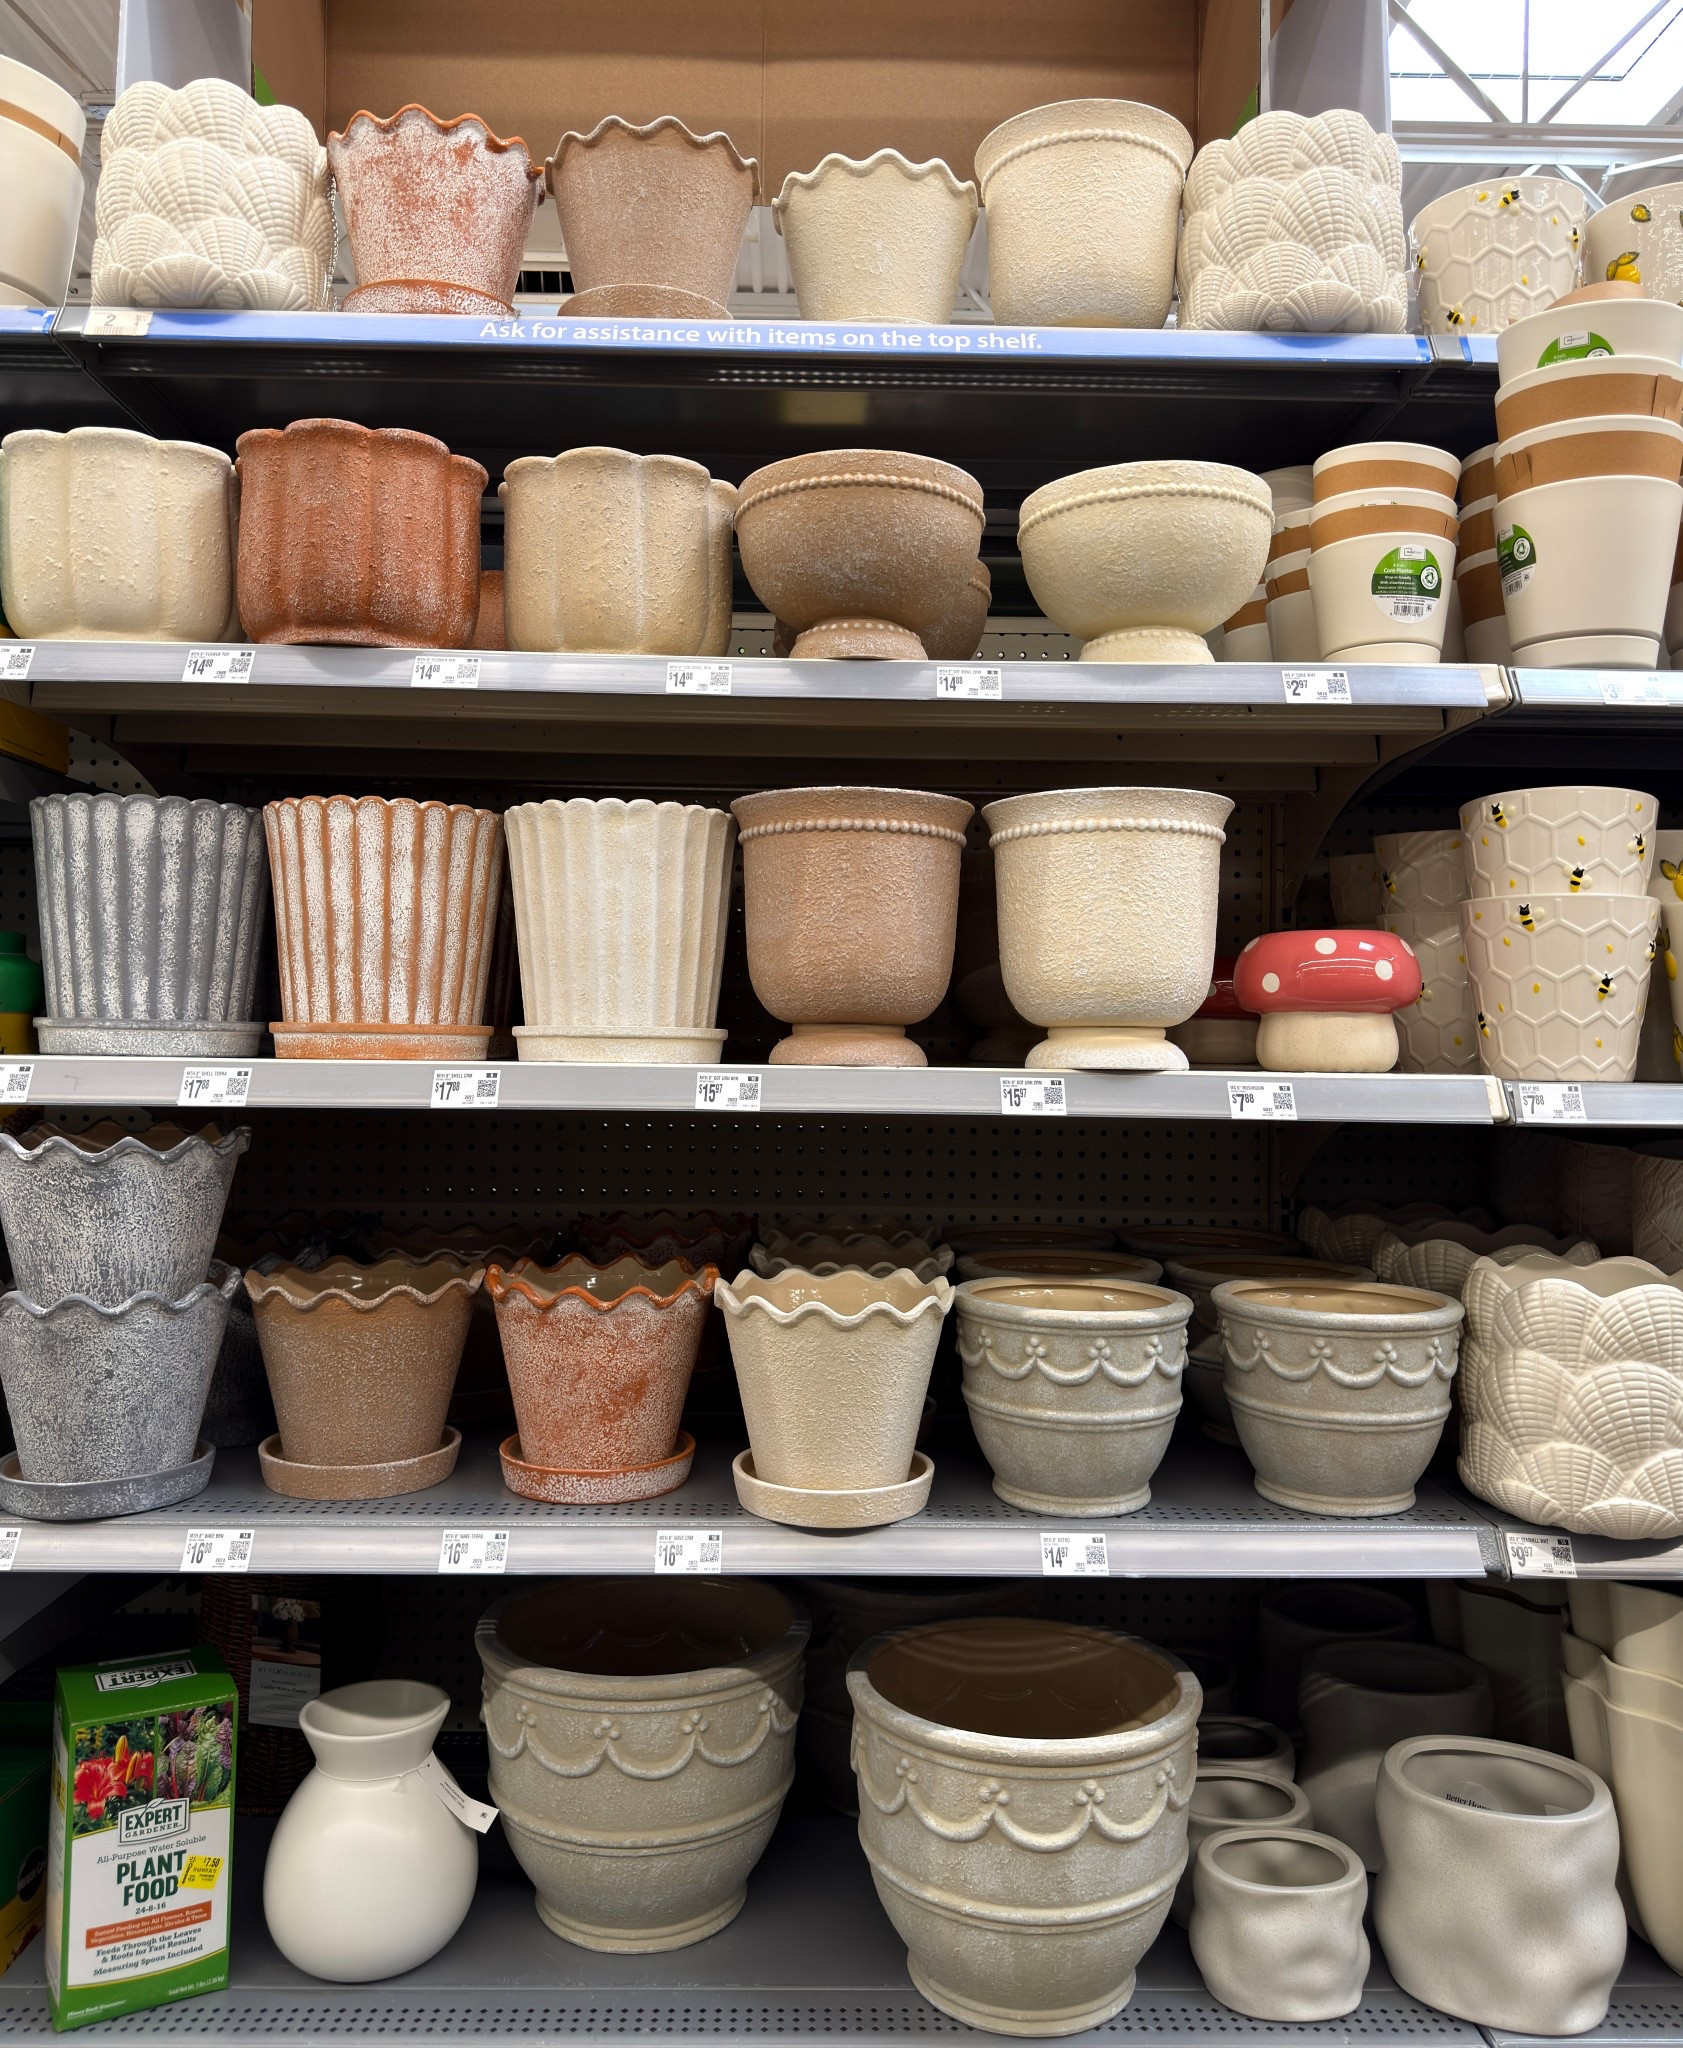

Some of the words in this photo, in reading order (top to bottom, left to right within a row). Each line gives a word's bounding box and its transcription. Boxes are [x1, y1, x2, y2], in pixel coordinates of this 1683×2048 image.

[104, 315, 116, 327] 2
[480, 322, 526, 338] Ask
[531, 322, 567, 339] for
[572, 325, 700, 343] assistance
[706, 327, 761, 343] with
[769, 328, 836, 345] items
[842, 333, 874, 347] on
[881, 331, 922, 347] the
[928, 333, 971, 352] top
[977, 333, 1042, 350] shelf.
[109, 1666, 187, 1687] EXPERT
[1445, 1793, 1468, 1805] Better
[125, 1804, 183, 1831] EXPERT
[97, 1849, 147, 1864] All-Purpose
[149, 1842, 174, 1854] Water
[175, 1835, 207, 1847] Soluble
[117, 1849, 187, 1884] PLANT
[123, 1875, 179, 1906] FOOD
[135, 1902, 167, 1914] 24-8-16
[116, 1922, 141, 1933] Feeding
[141, 1918, 151, 1927] for
[151, 1916, 160, 1924] All
[96, 1947, 121, 1957] Feeds
[122, 1939, 157, 1951] Through
[159, 1935, 172, 1944] the
[173, 1927, 202, 1939] Leaves
[110, 1951, 134, 1962] Roots
[135, 1948, 147, 1957] for
[149, 1944, 165, 1953] Fast
[167, 1936, 197, 1948] Results
[93, 1961, 139, 1977] Measuring
[141, 1955, 166, 1967] Spoon
[167, 1944, 204, 1959] Included
